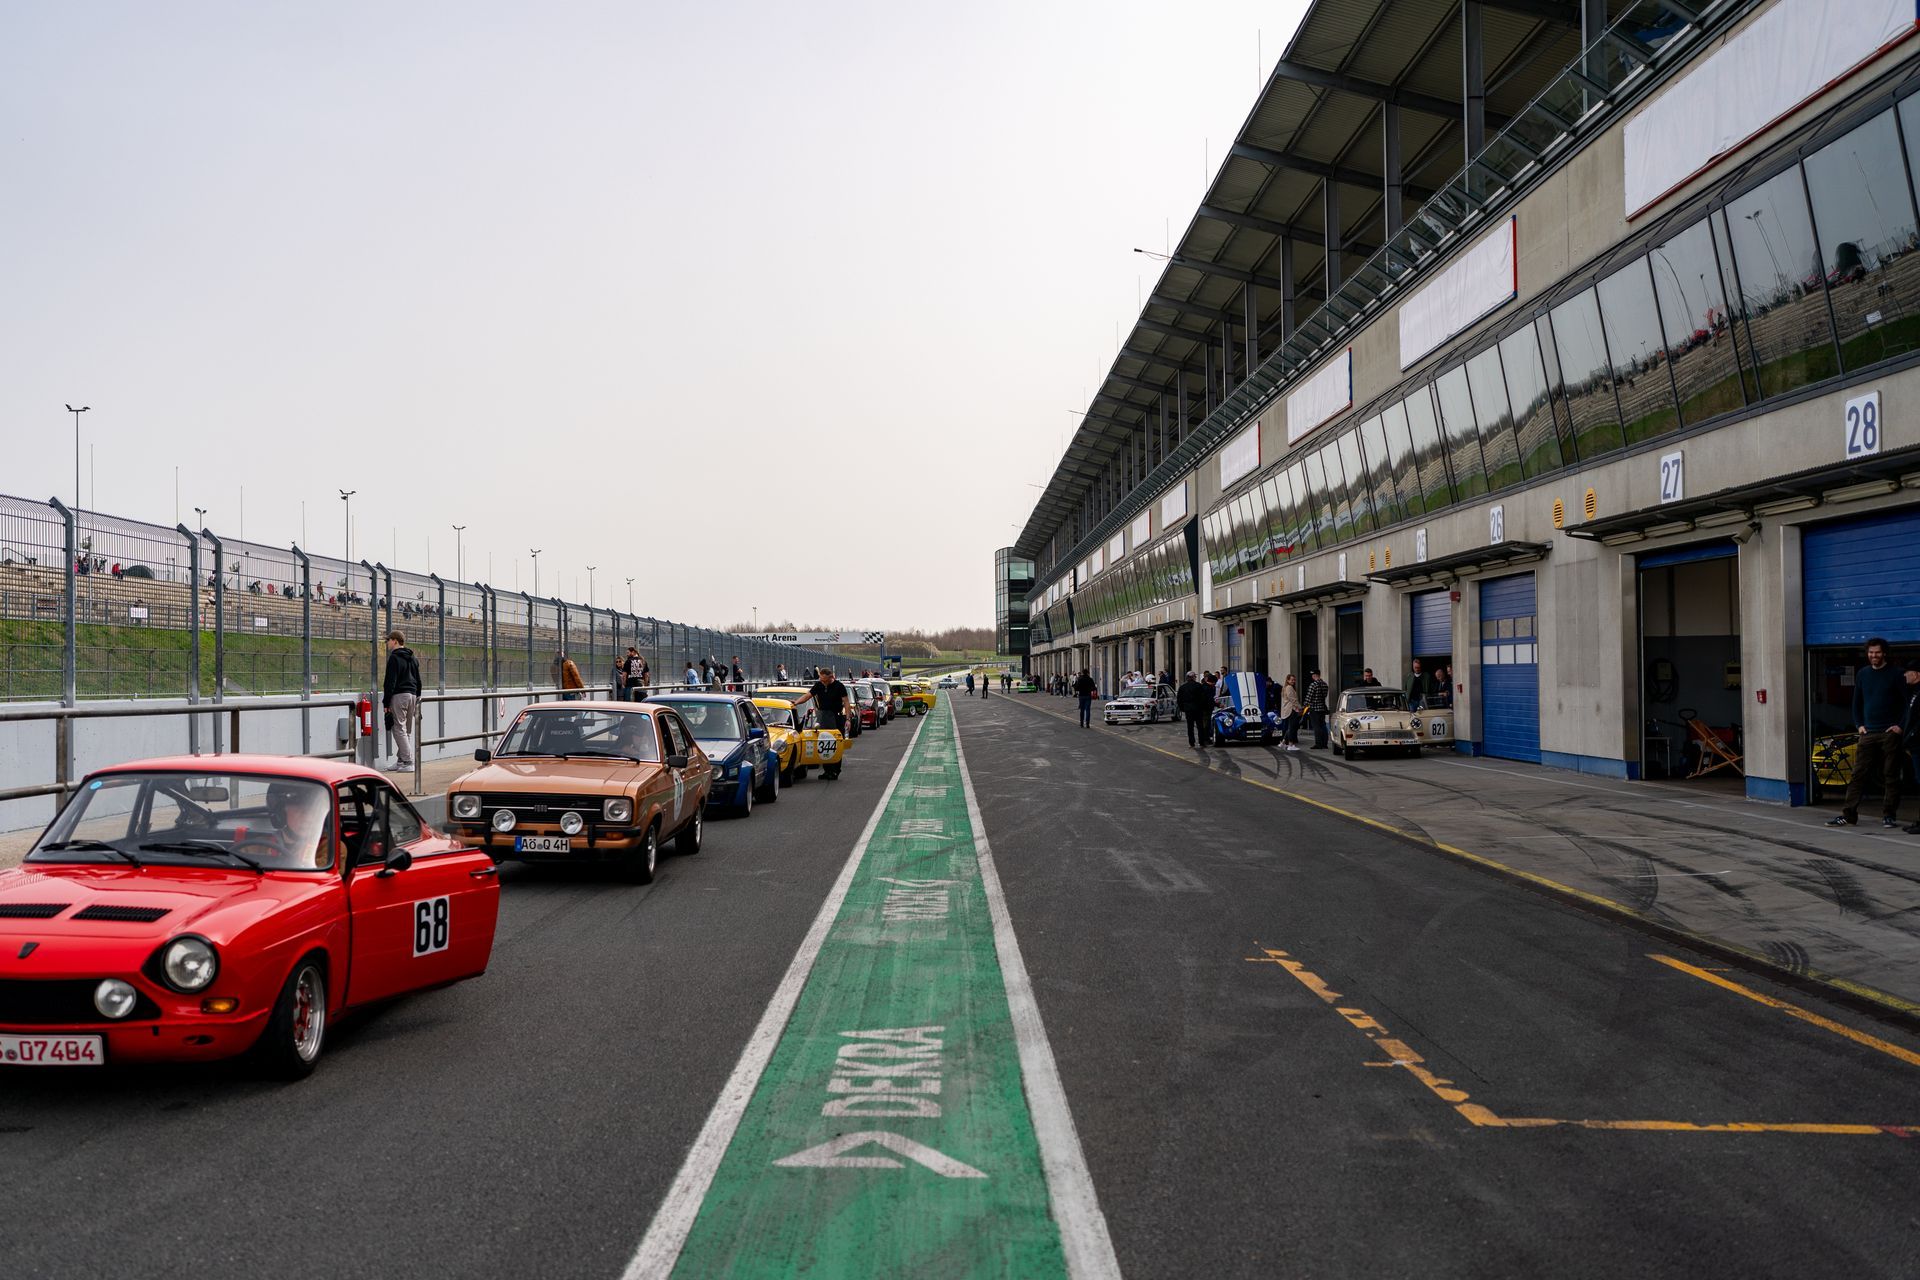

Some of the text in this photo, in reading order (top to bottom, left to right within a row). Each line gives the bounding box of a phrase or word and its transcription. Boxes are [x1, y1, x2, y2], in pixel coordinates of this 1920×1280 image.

[1847, 400, 1877, 454] 28
[1662, 459, 1681, 499] 27
[1490, 511, 1503, 541] 26
[817, 740, 837, 753] 344
[1432, 723, 1445, 735] 821
[521, 838, 568, 851] AÖ Q 4H
[416, 898, 447, 953] 68
[822, 1025, 946, 1118] DEKRA
